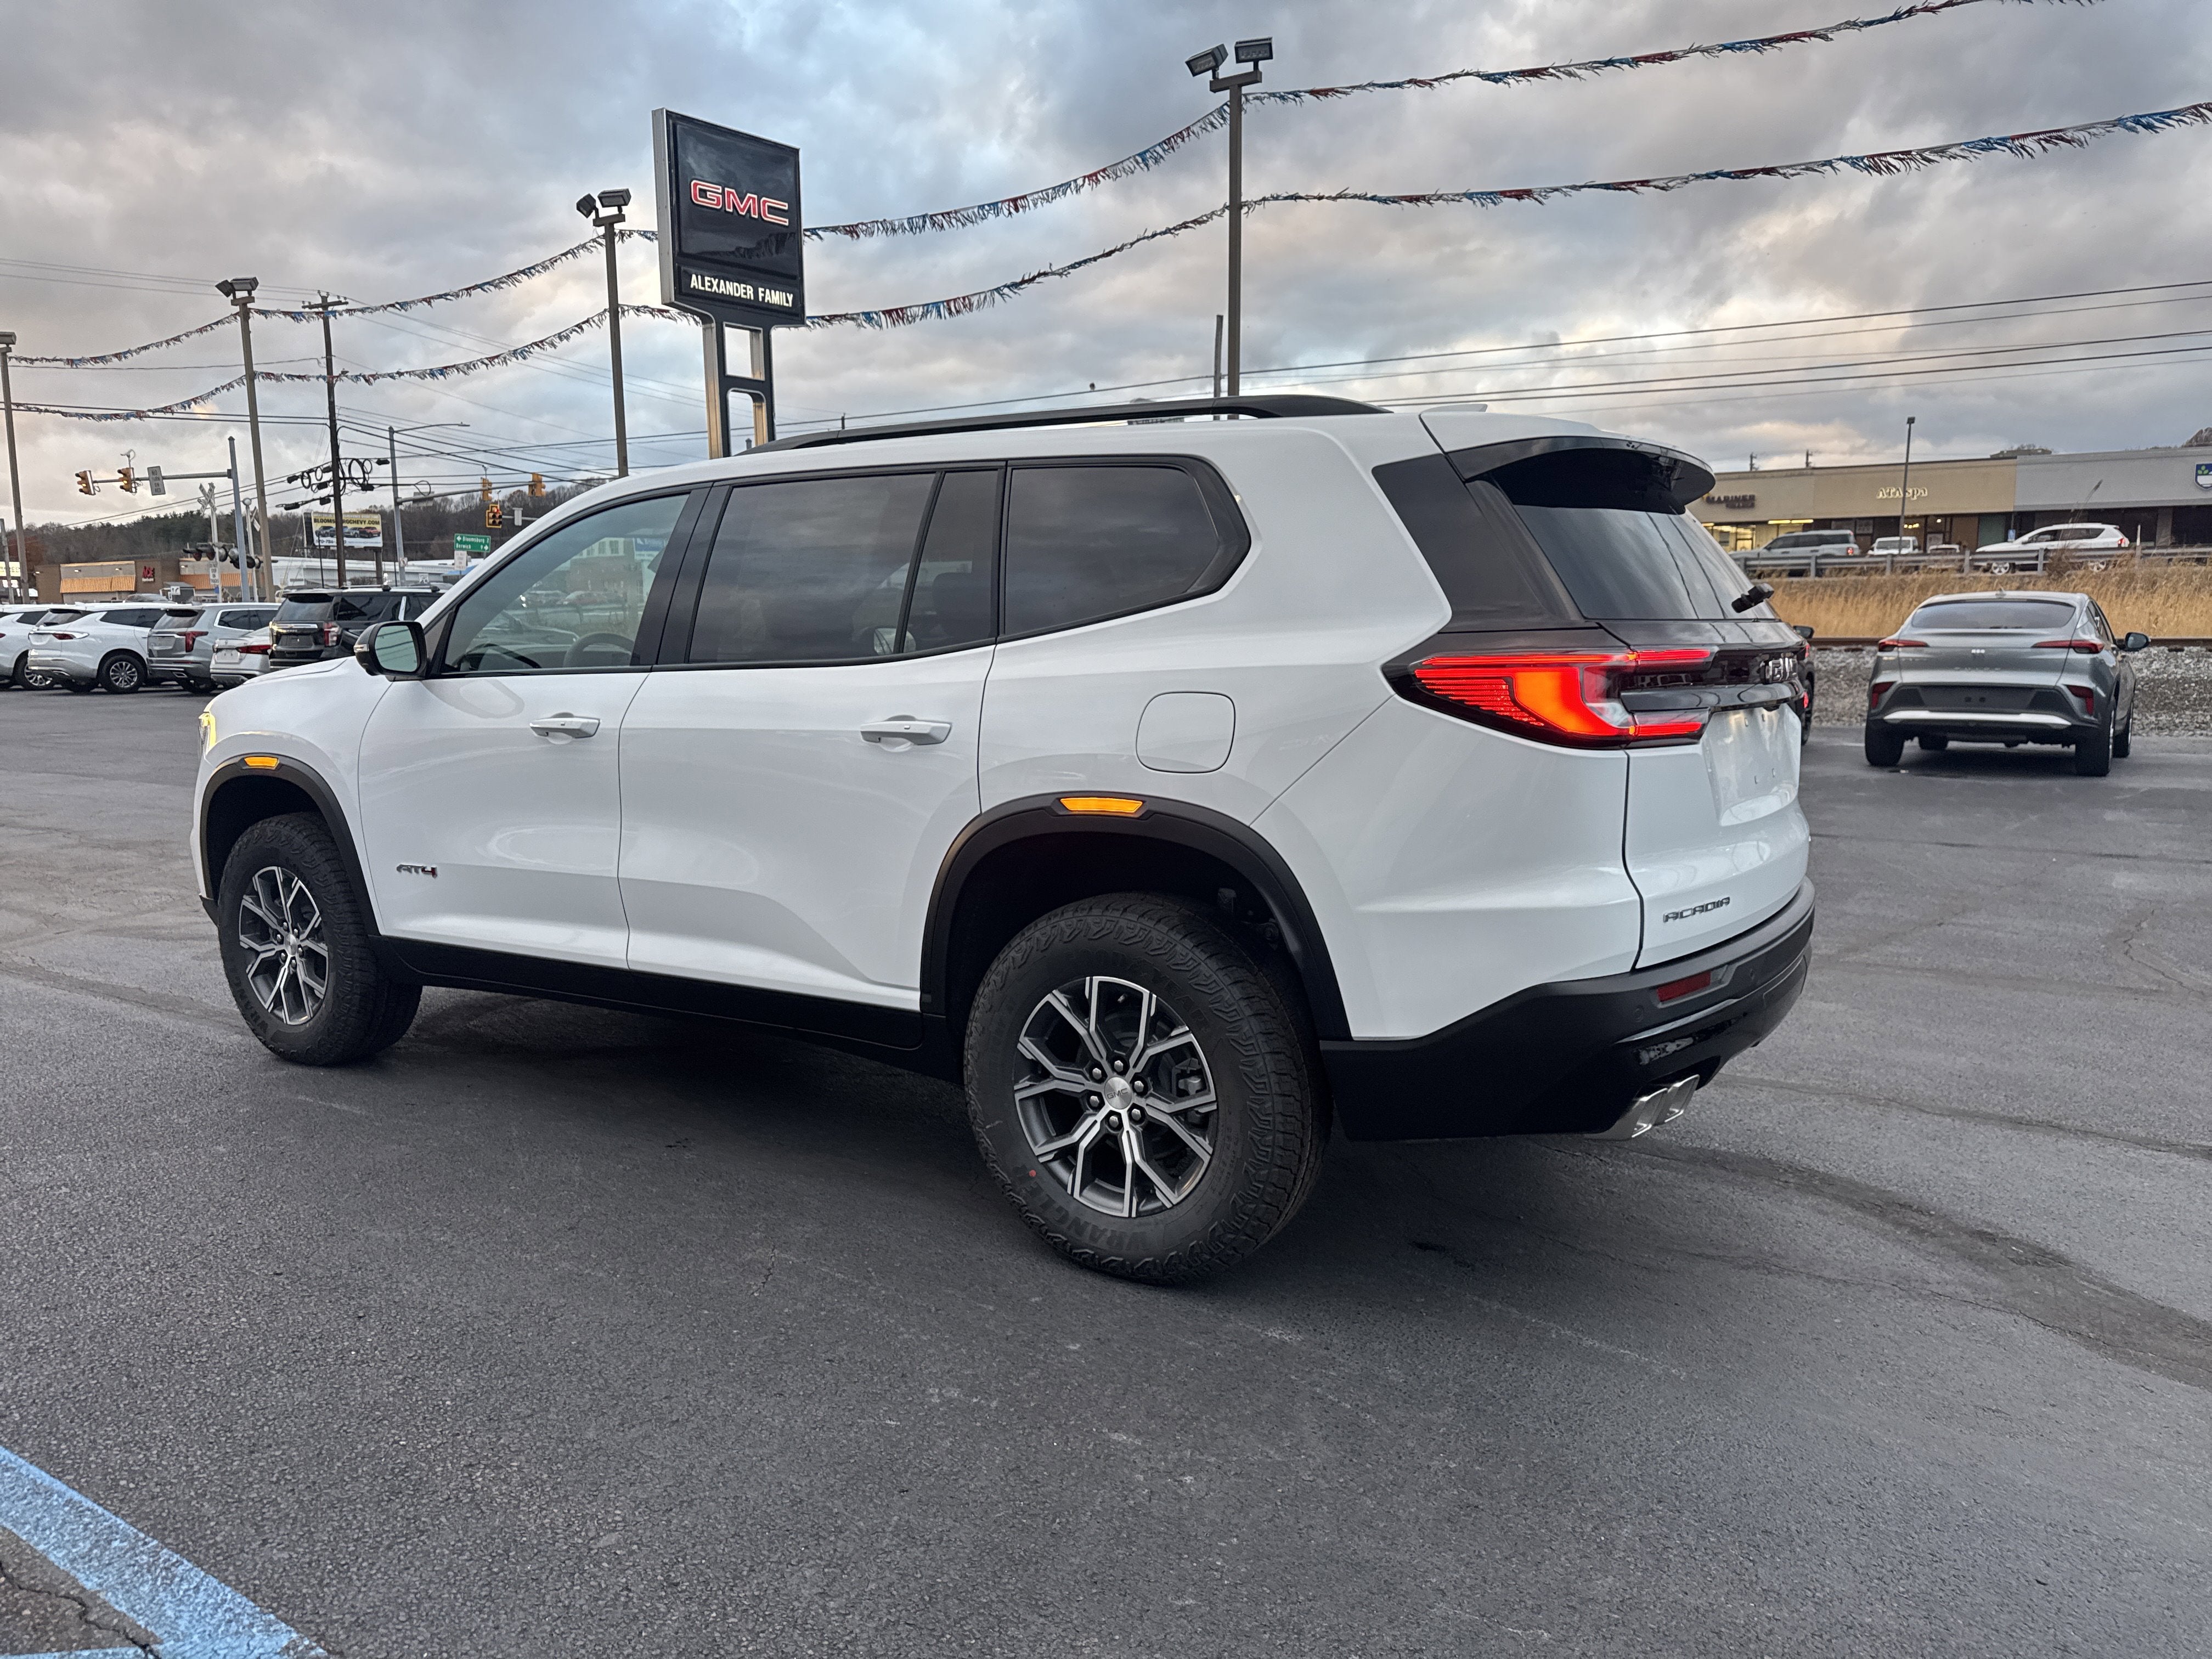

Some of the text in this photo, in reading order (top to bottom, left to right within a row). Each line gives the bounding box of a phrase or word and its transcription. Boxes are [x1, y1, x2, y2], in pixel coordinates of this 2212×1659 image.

[691, 179, 788, 226] GMC
[690, 274, 793, 307] ALEXANDER FAMILY
[1706, 495, 1755, 504] MARINER
[142, 566, 155, 578] ACE
[396, 864, 438, 878] AT4
[1663, 896, 1730, 923] ACADIA
[1107, 1087, 1128, 1099] GMC
